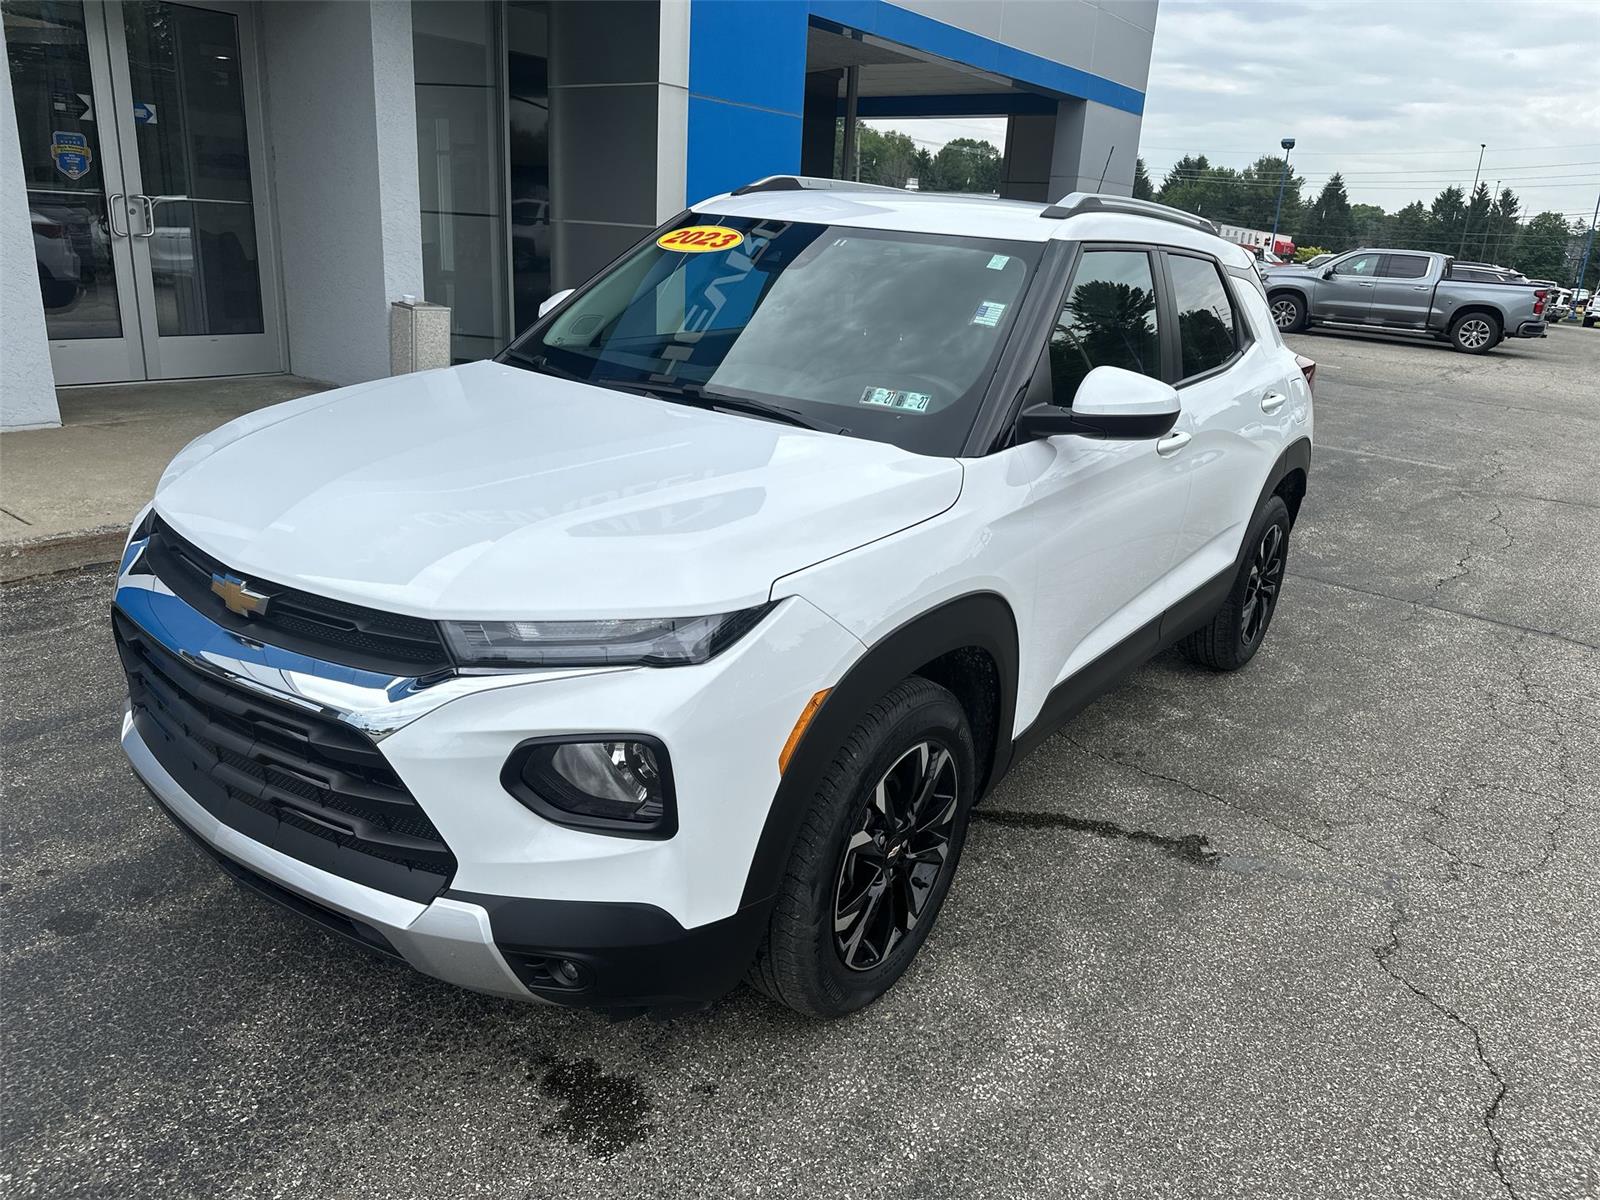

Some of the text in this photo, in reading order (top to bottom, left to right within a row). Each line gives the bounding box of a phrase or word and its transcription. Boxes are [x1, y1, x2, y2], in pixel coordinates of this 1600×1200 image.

[662, 230, 738, 248] 2023
[884, 391, 895, 404] 27
[917, 396, 929, 410] 27
